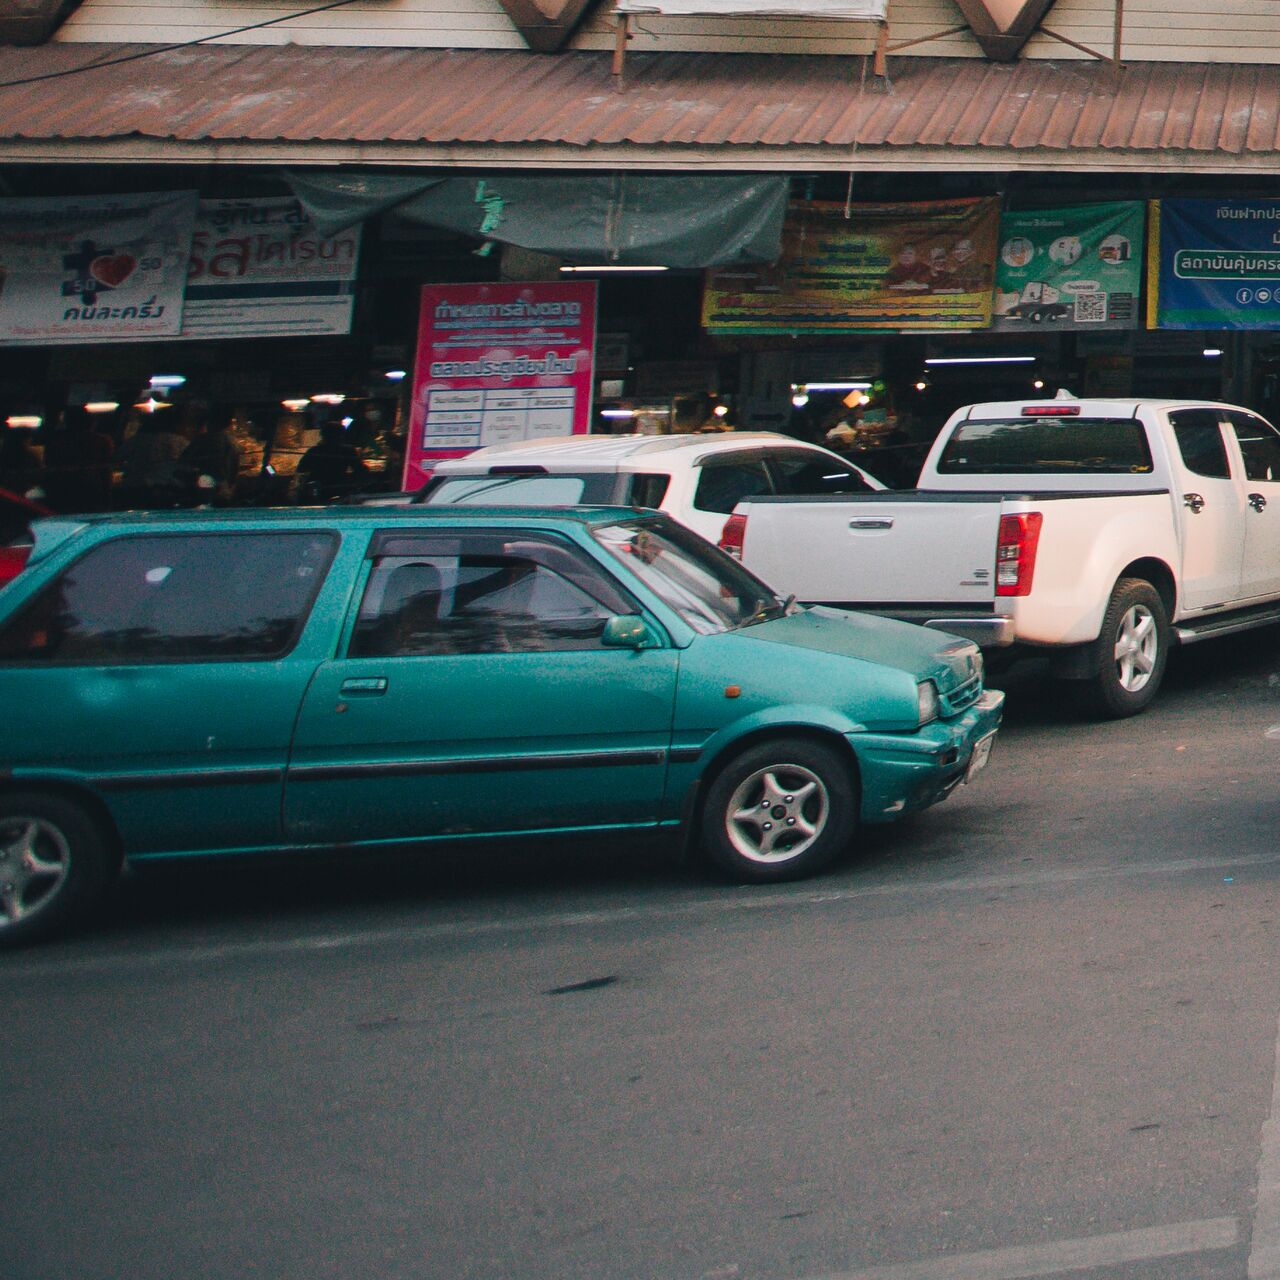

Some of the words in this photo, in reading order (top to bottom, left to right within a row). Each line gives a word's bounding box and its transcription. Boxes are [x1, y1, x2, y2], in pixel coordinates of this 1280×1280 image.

[62, 294, 165, 321] คนละครึ่ง
[430, 352, 577, 381] ตลาดประตูเชียงใหม่
